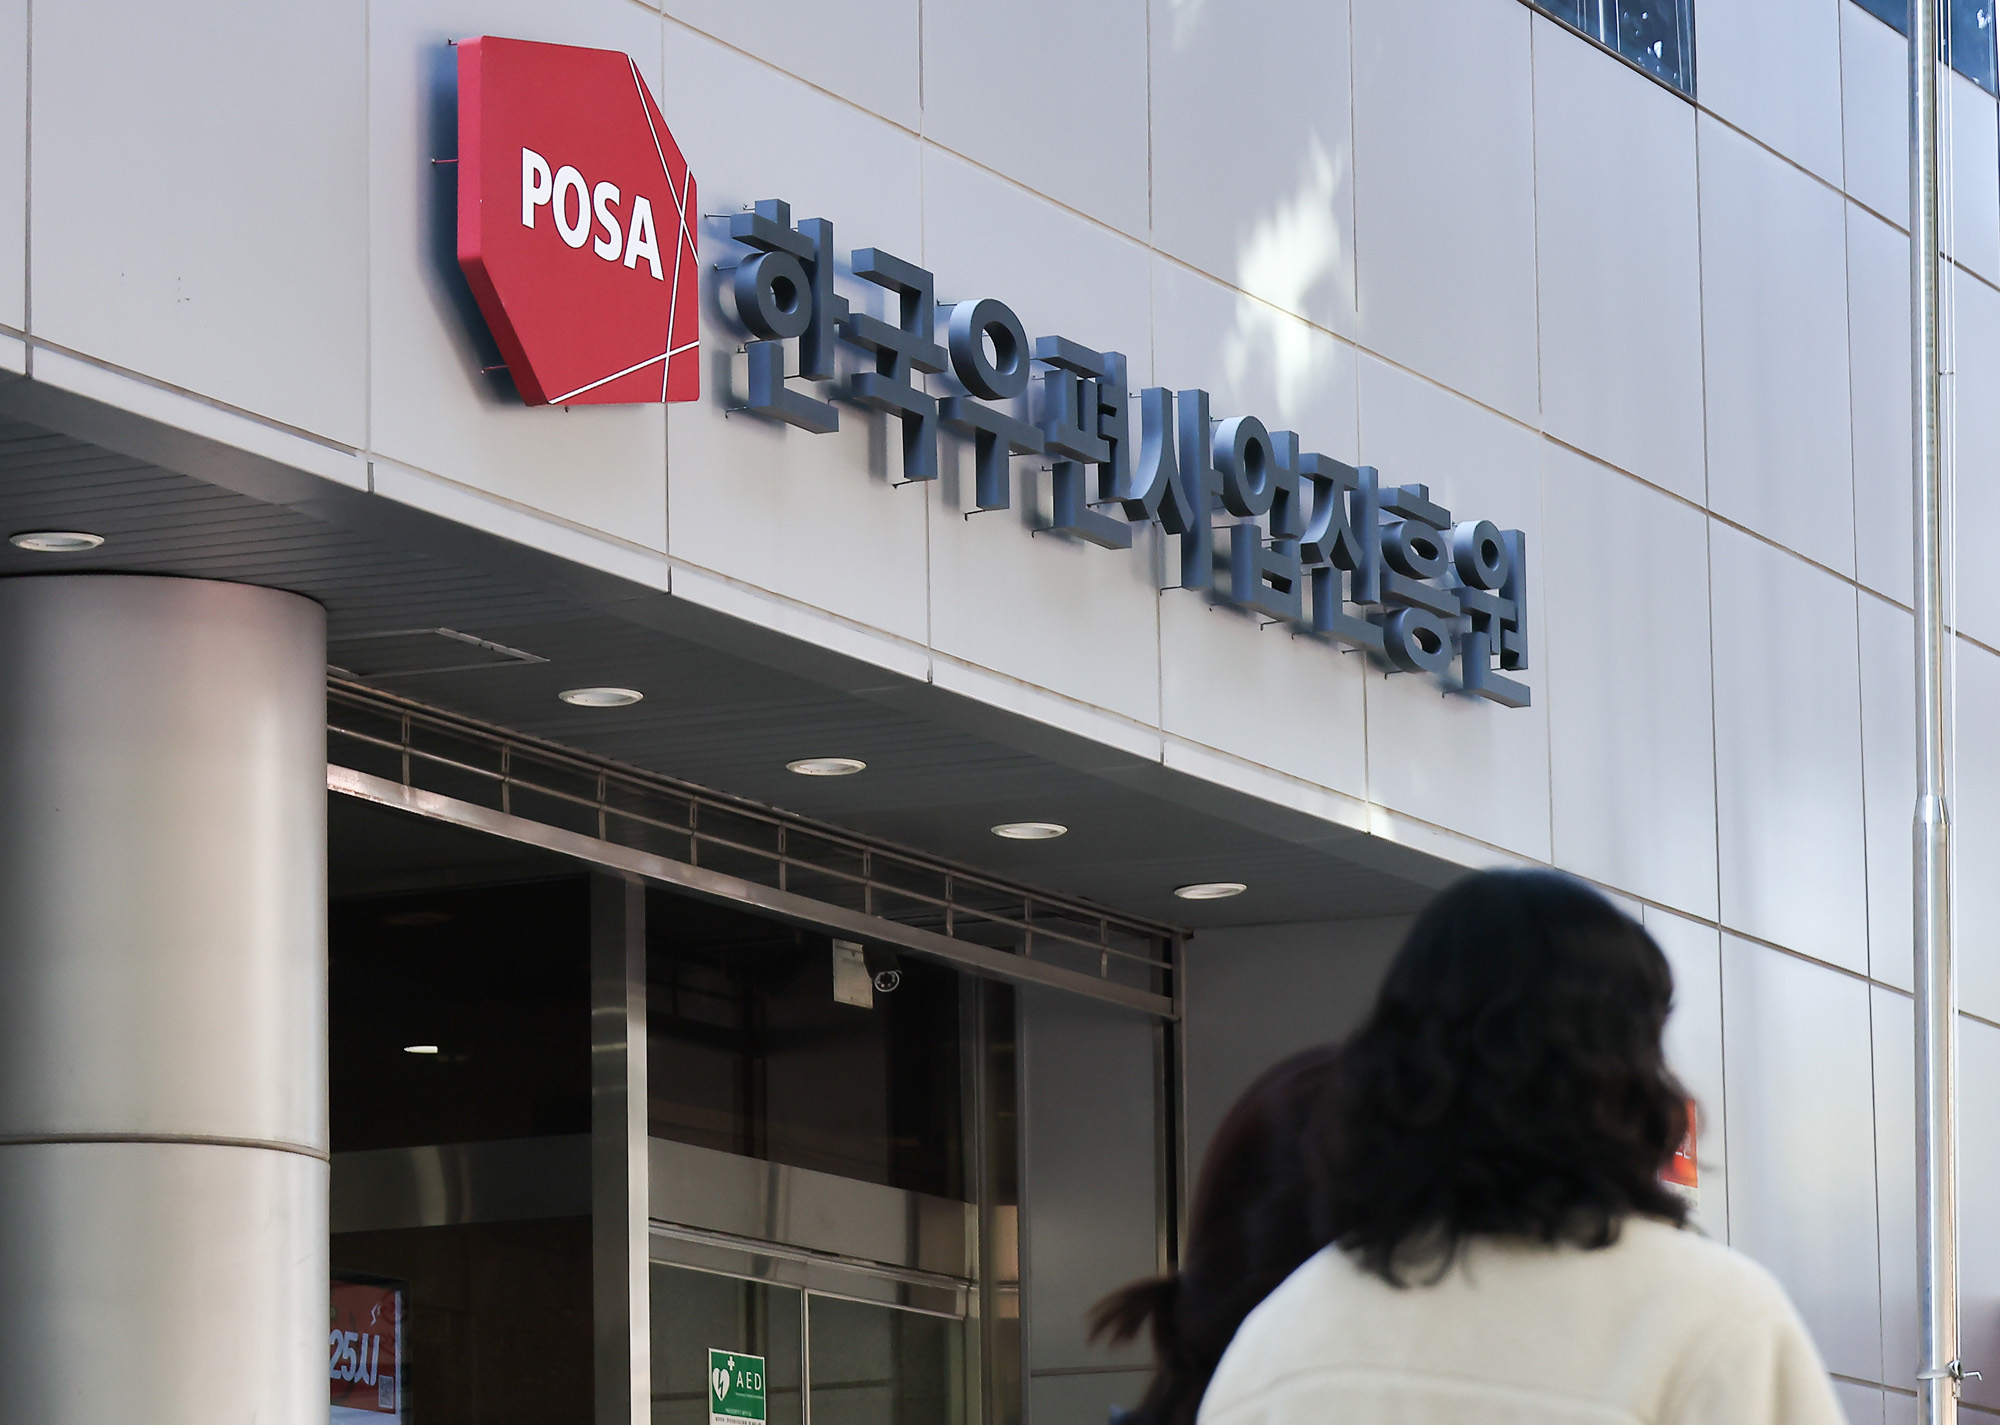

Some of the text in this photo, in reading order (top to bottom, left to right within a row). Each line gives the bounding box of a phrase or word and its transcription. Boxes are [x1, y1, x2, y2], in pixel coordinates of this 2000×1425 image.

[521, 147, 664, 281] POSA
[731, 199, 1530, 707] 한국우편사업진흥원
[736, 1370, 762, 1391] AED
